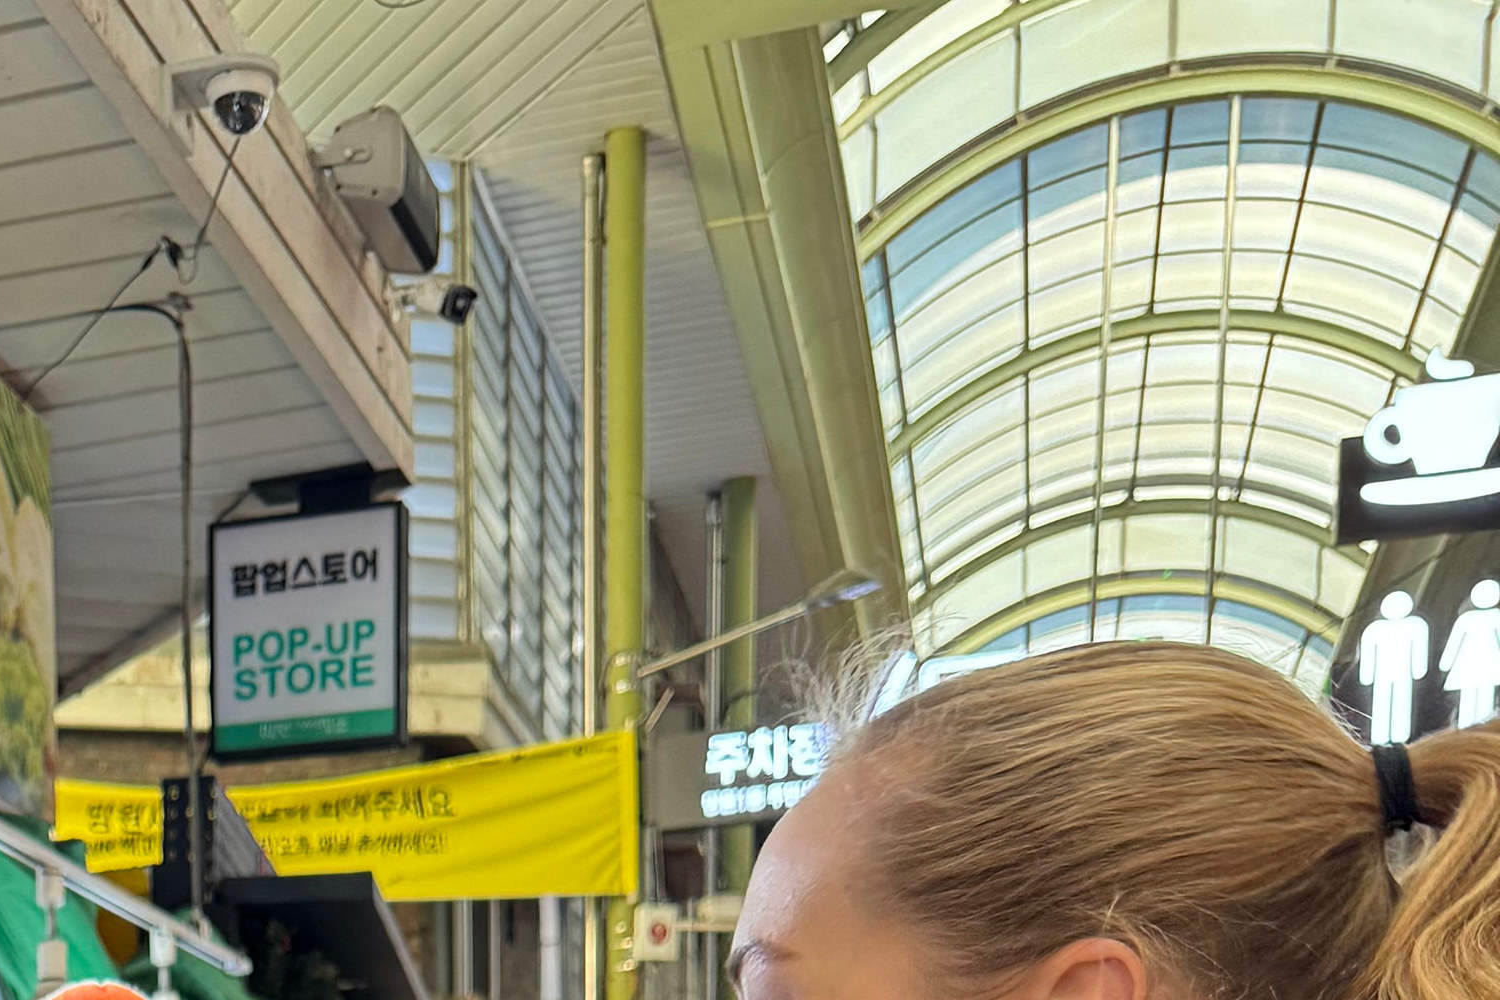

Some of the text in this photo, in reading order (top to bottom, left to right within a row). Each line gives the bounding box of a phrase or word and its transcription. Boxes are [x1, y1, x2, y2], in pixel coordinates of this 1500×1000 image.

[231, 547, 380, 598] 팝업스토어
[233, 619, 376, 666] POP-UP
[233, 655, 376, 702] STORE
